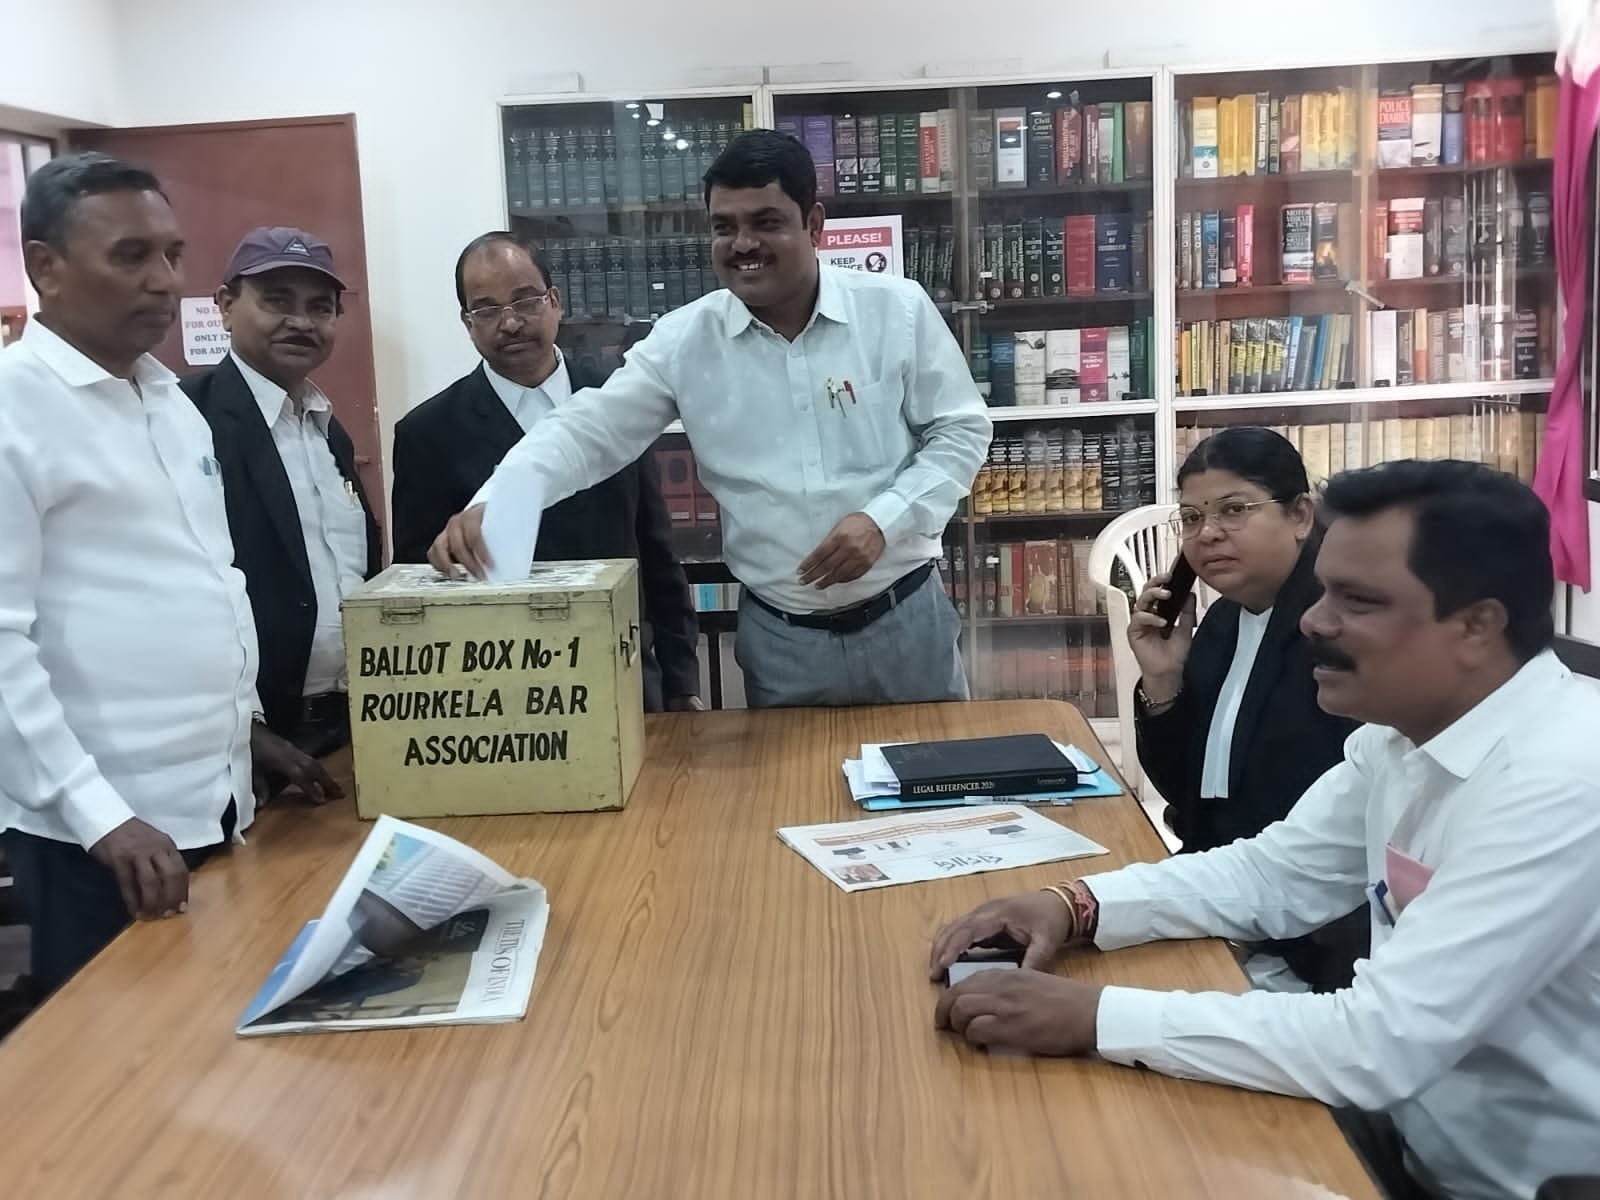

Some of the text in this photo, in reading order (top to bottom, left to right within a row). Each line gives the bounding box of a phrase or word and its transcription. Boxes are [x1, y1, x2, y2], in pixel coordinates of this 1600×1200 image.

[827, 232, 882, 246] PLEASE!
[830, 257, 856, 265] KEEP
[194, 334, 217, 342] ONLY
[360, 642, 450, 677] BALLOT
[462, 639, 515, 673] BOX
[361, 685, 588, 721] ROURKELA BAR
[404, 730, 568, 766] ASSOCIATION
[913, 784, 935, 794] LEGAL
[935, 782, 980, 792] REFERENCER
